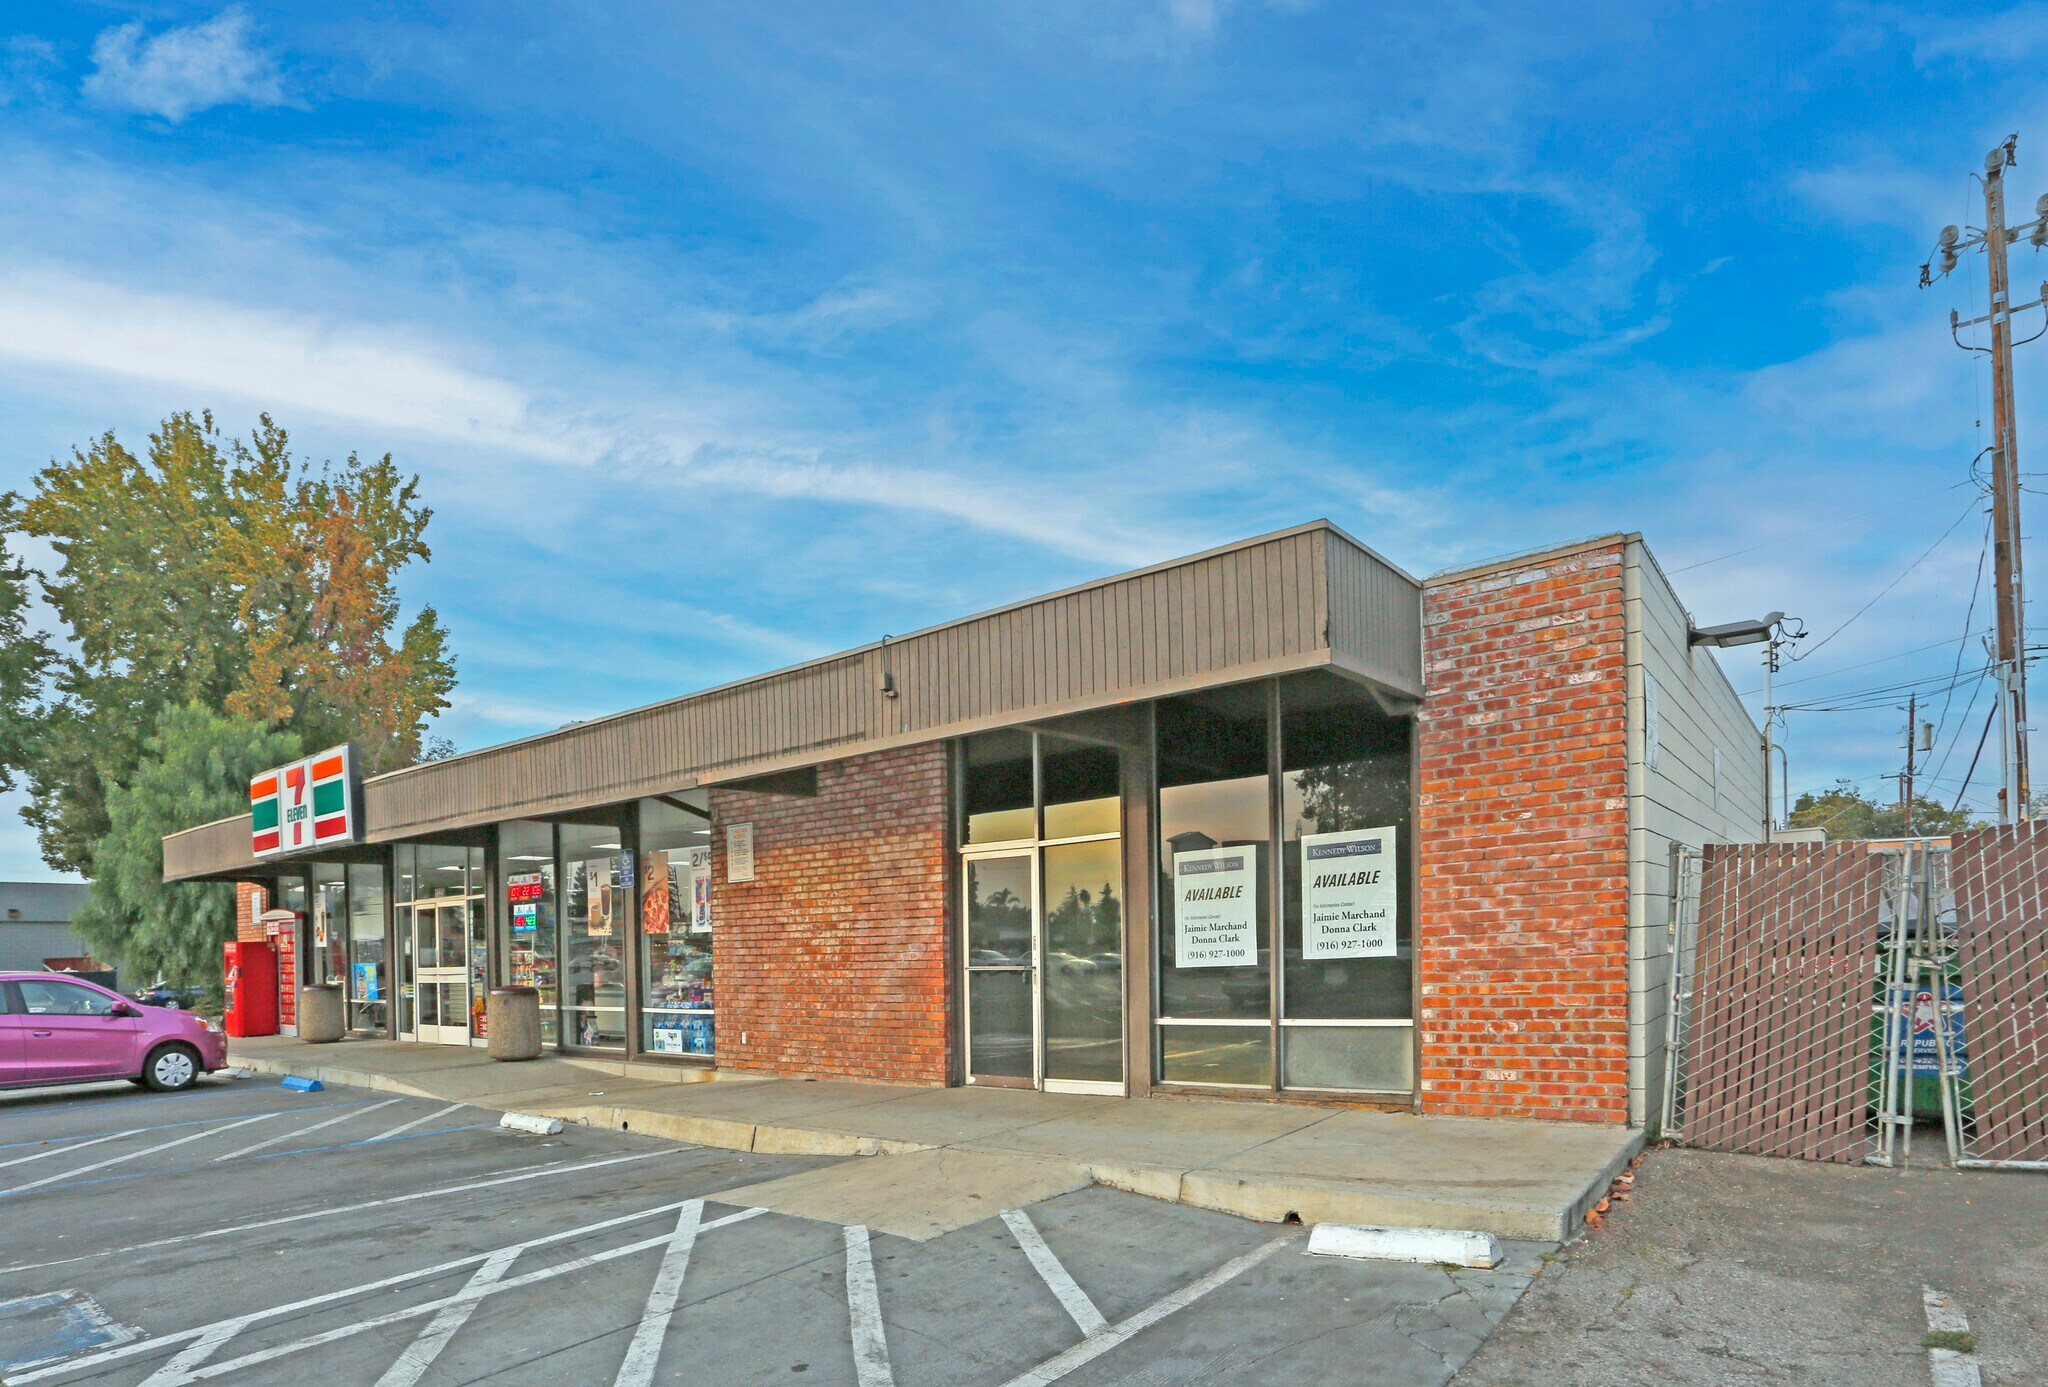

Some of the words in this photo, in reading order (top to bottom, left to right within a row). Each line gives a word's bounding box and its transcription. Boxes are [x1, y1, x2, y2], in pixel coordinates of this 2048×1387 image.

[1313, 870, 1381, 888] AVAILABLE
[1184, 885, 1244, 902] AVAILABLE
[1313, 912, 1340, 924] Jaimie
[1341, 908, 1386, 920] Marchand
[1184, 924, 1208, 934] Jaimie
[1209, 921, 1248, 932] Marchand
[1321, 925, 1351, 934] Donna
[1352, 922, 1377, 932] Clark
[1191, 935, 1217, 944] Donna
[1218, 933, 1240, 943] Clark
[1316, 940, 1339, 951] (916)
[1341, 939, 1383, 949] 927-1000
[1187, 951, 1207, 960] (916)
[1208, 949, 1246, 958] 927-1000
